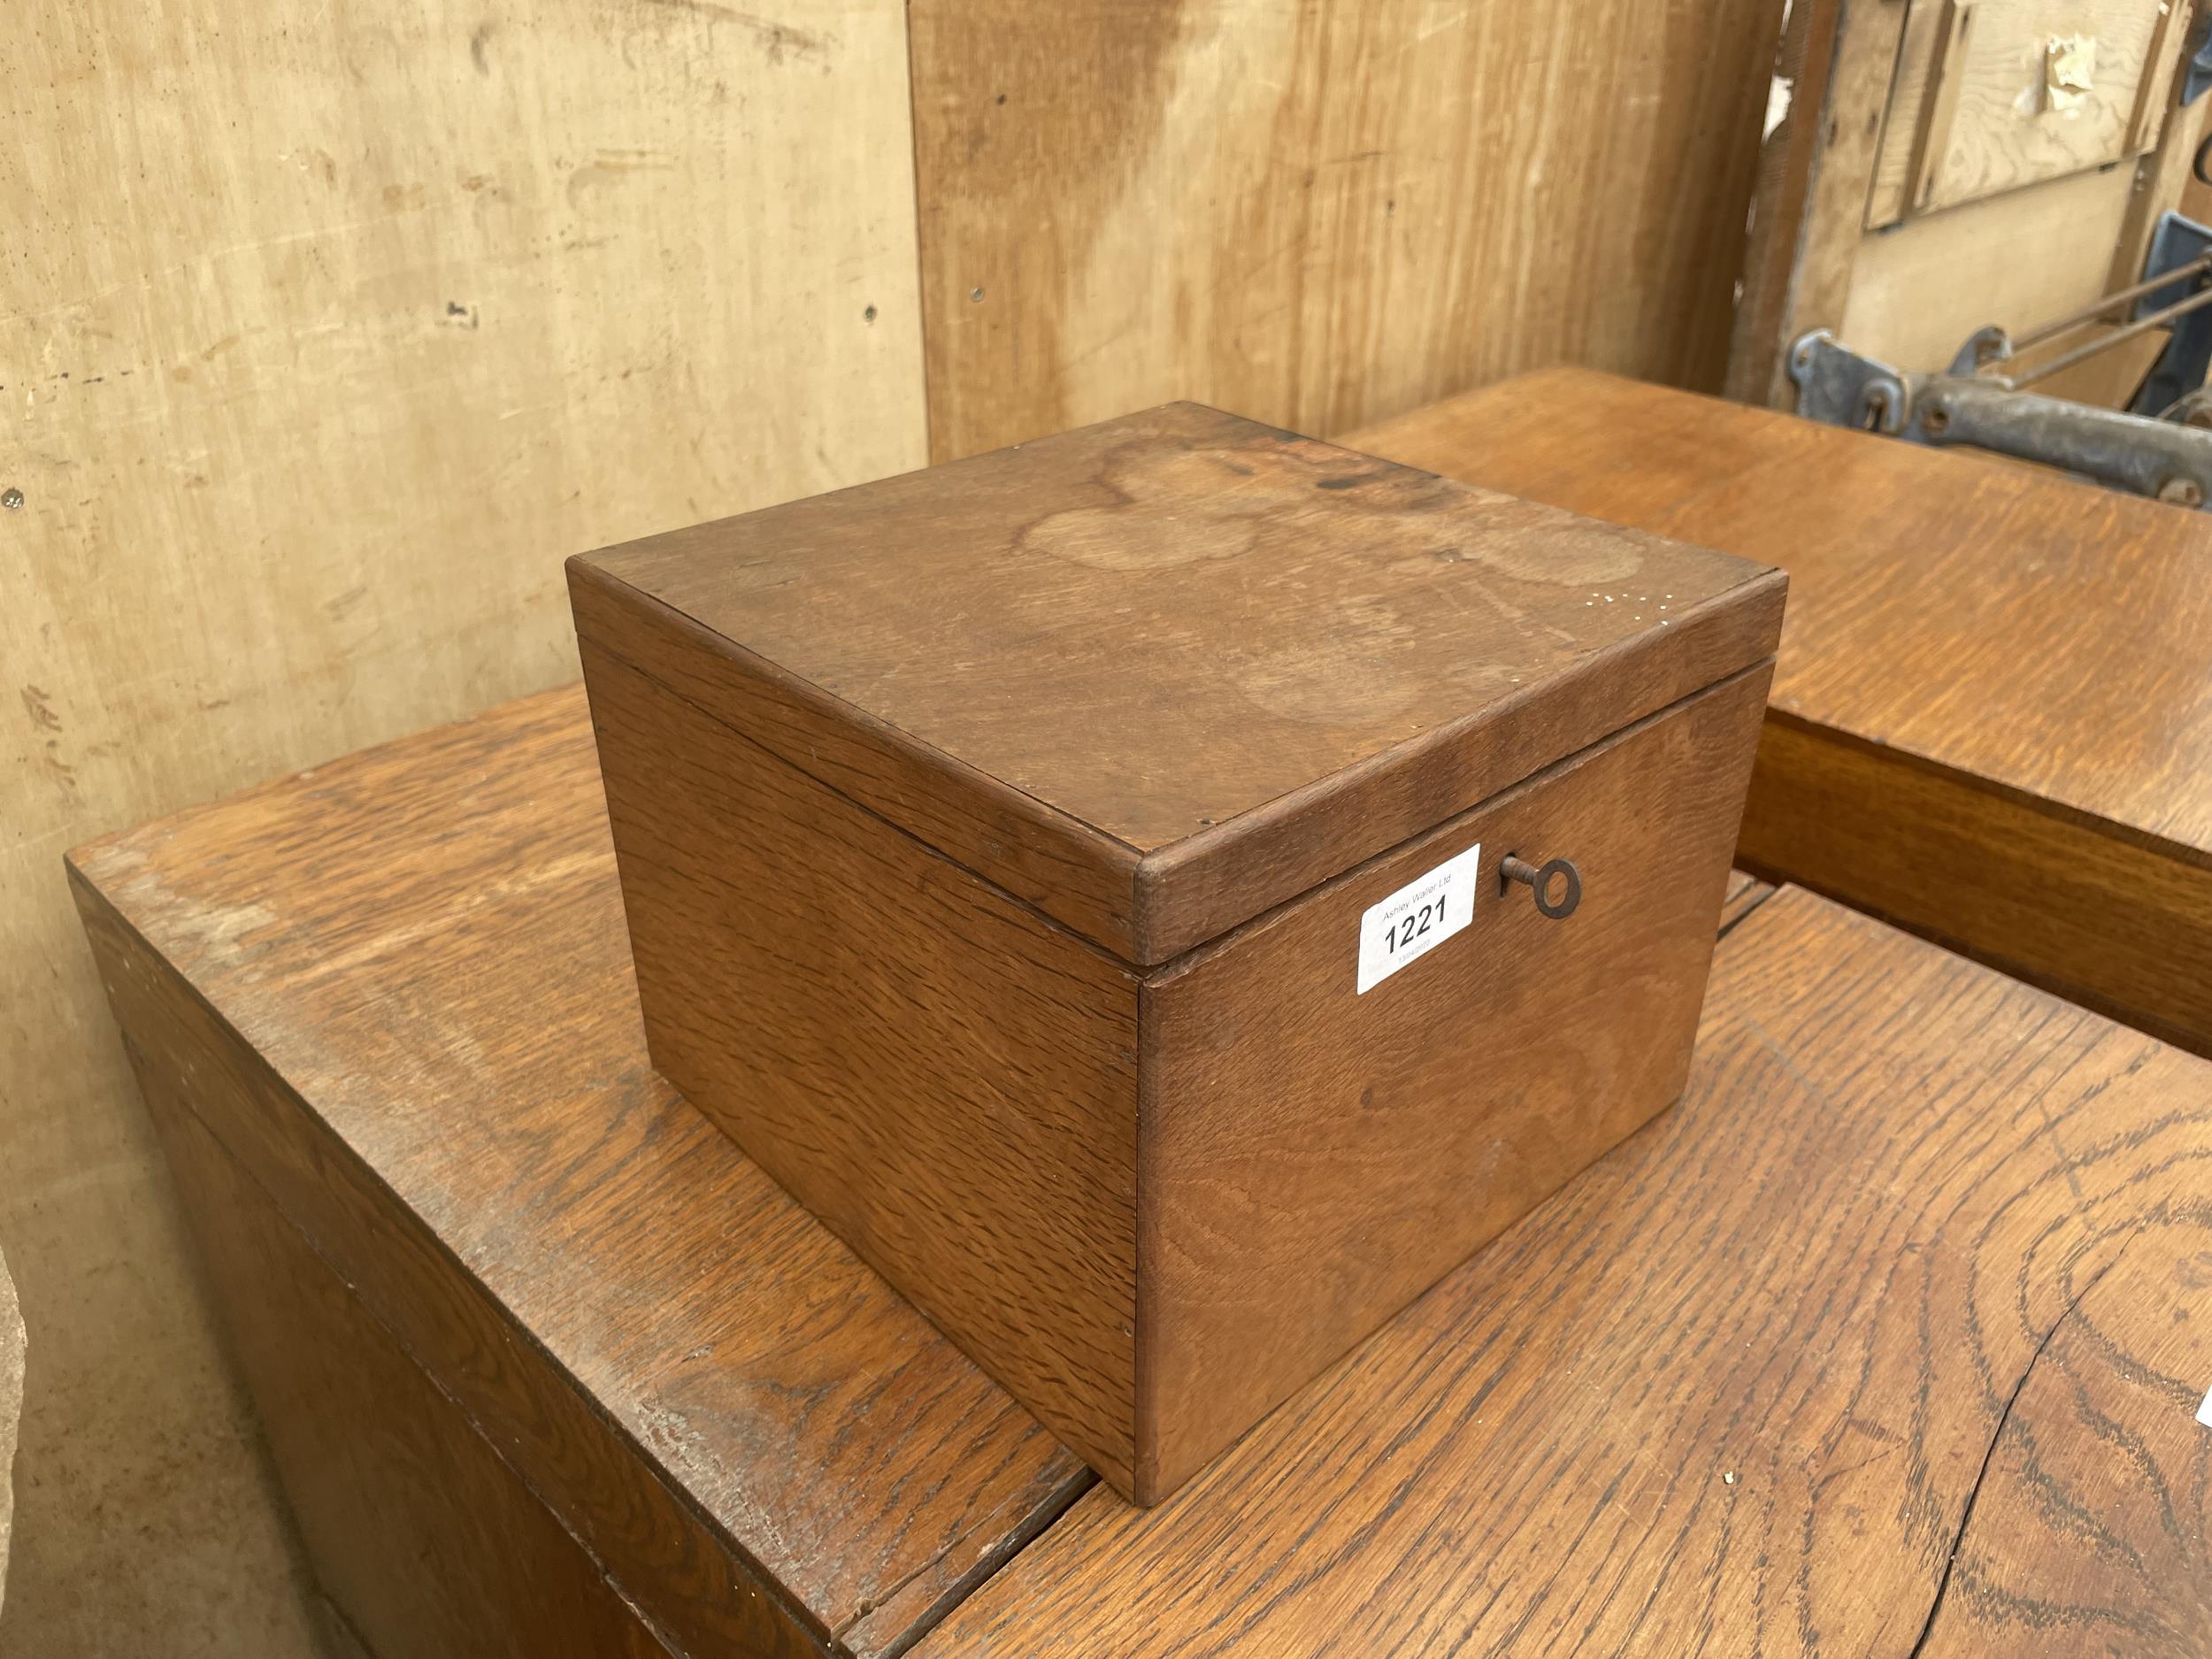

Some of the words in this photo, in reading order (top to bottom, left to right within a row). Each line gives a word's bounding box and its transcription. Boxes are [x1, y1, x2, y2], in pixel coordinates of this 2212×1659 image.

[1382, 900, 1410, 922] Ashley
[1439, 873, 1452, 888] Ltd
[1385, 894, 1446, 955] 1221
